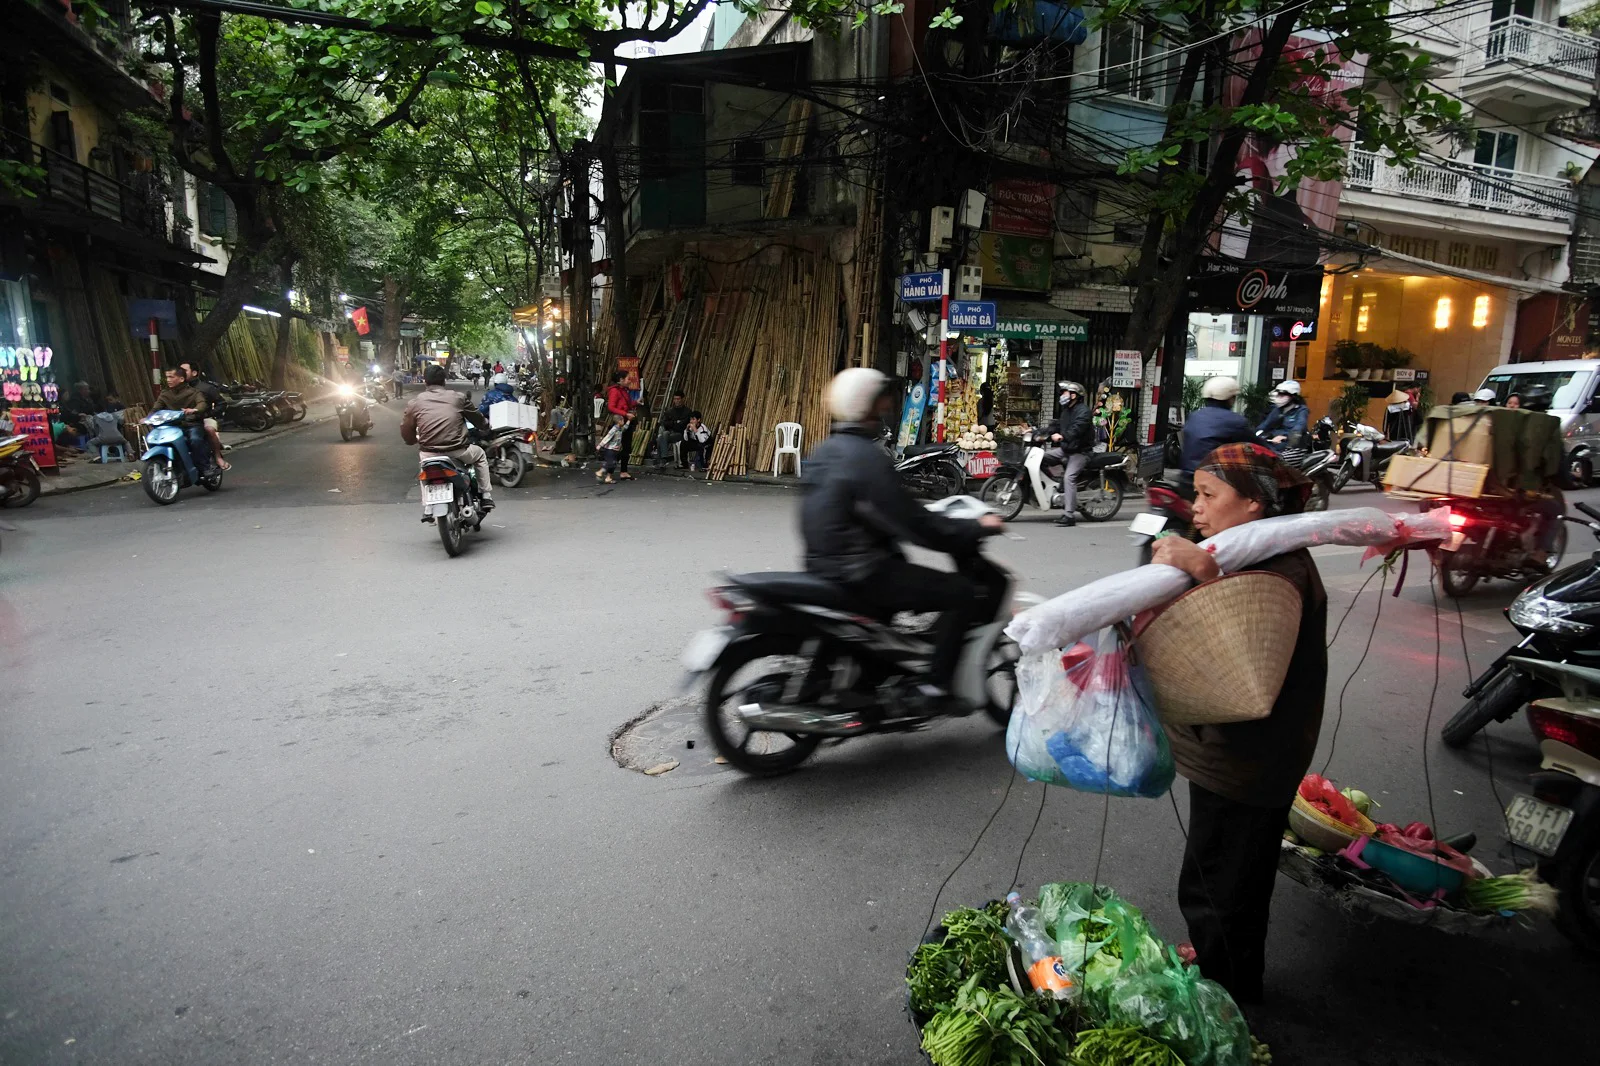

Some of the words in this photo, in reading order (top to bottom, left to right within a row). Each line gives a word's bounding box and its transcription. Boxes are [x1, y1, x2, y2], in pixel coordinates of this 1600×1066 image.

[919, 276, 932, 284] PHỐ
[904, 286, 926, 297] HÀNG
[928, 282, 941, 296] VẢI
[967, 305, 982, 313] PHỐ
[952, 313, 977, 325] HÀNG
[979, 313, 992, 325] GÀ
[995, 322, 1031, 332] HÀNG
[1035, 324, 1057, 335] TẠP
[1556, 335, 1582, 344] MONTES
